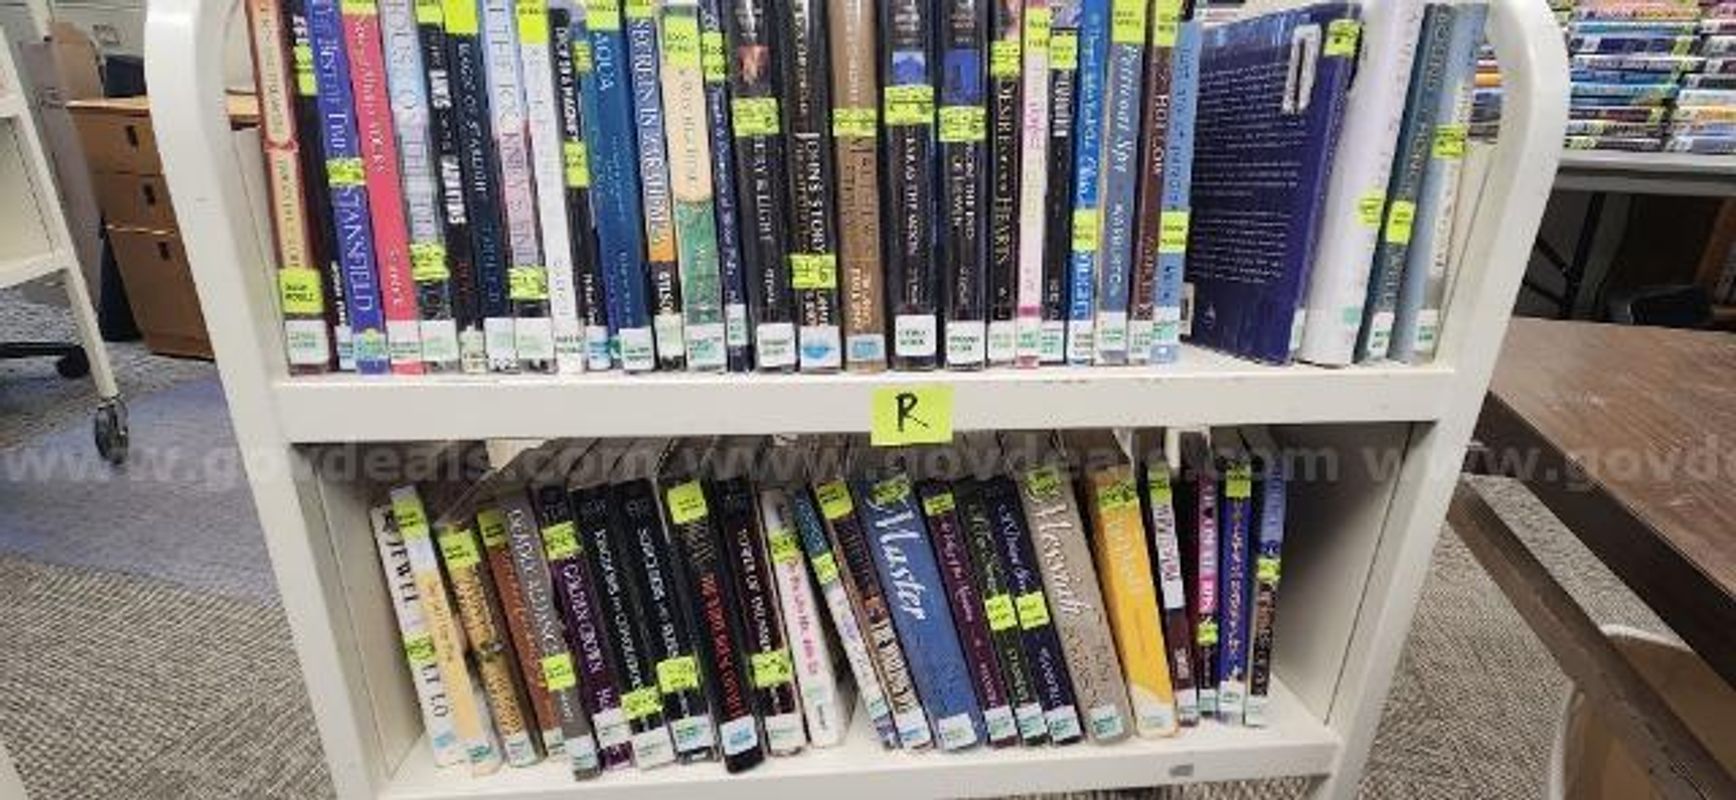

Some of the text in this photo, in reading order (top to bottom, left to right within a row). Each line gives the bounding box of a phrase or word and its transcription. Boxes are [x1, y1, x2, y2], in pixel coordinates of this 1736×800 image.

[895, 392, 929, 433] R
[866, 498, 926, 621] Master
[1026, 492, 1091, 615] Messiah
